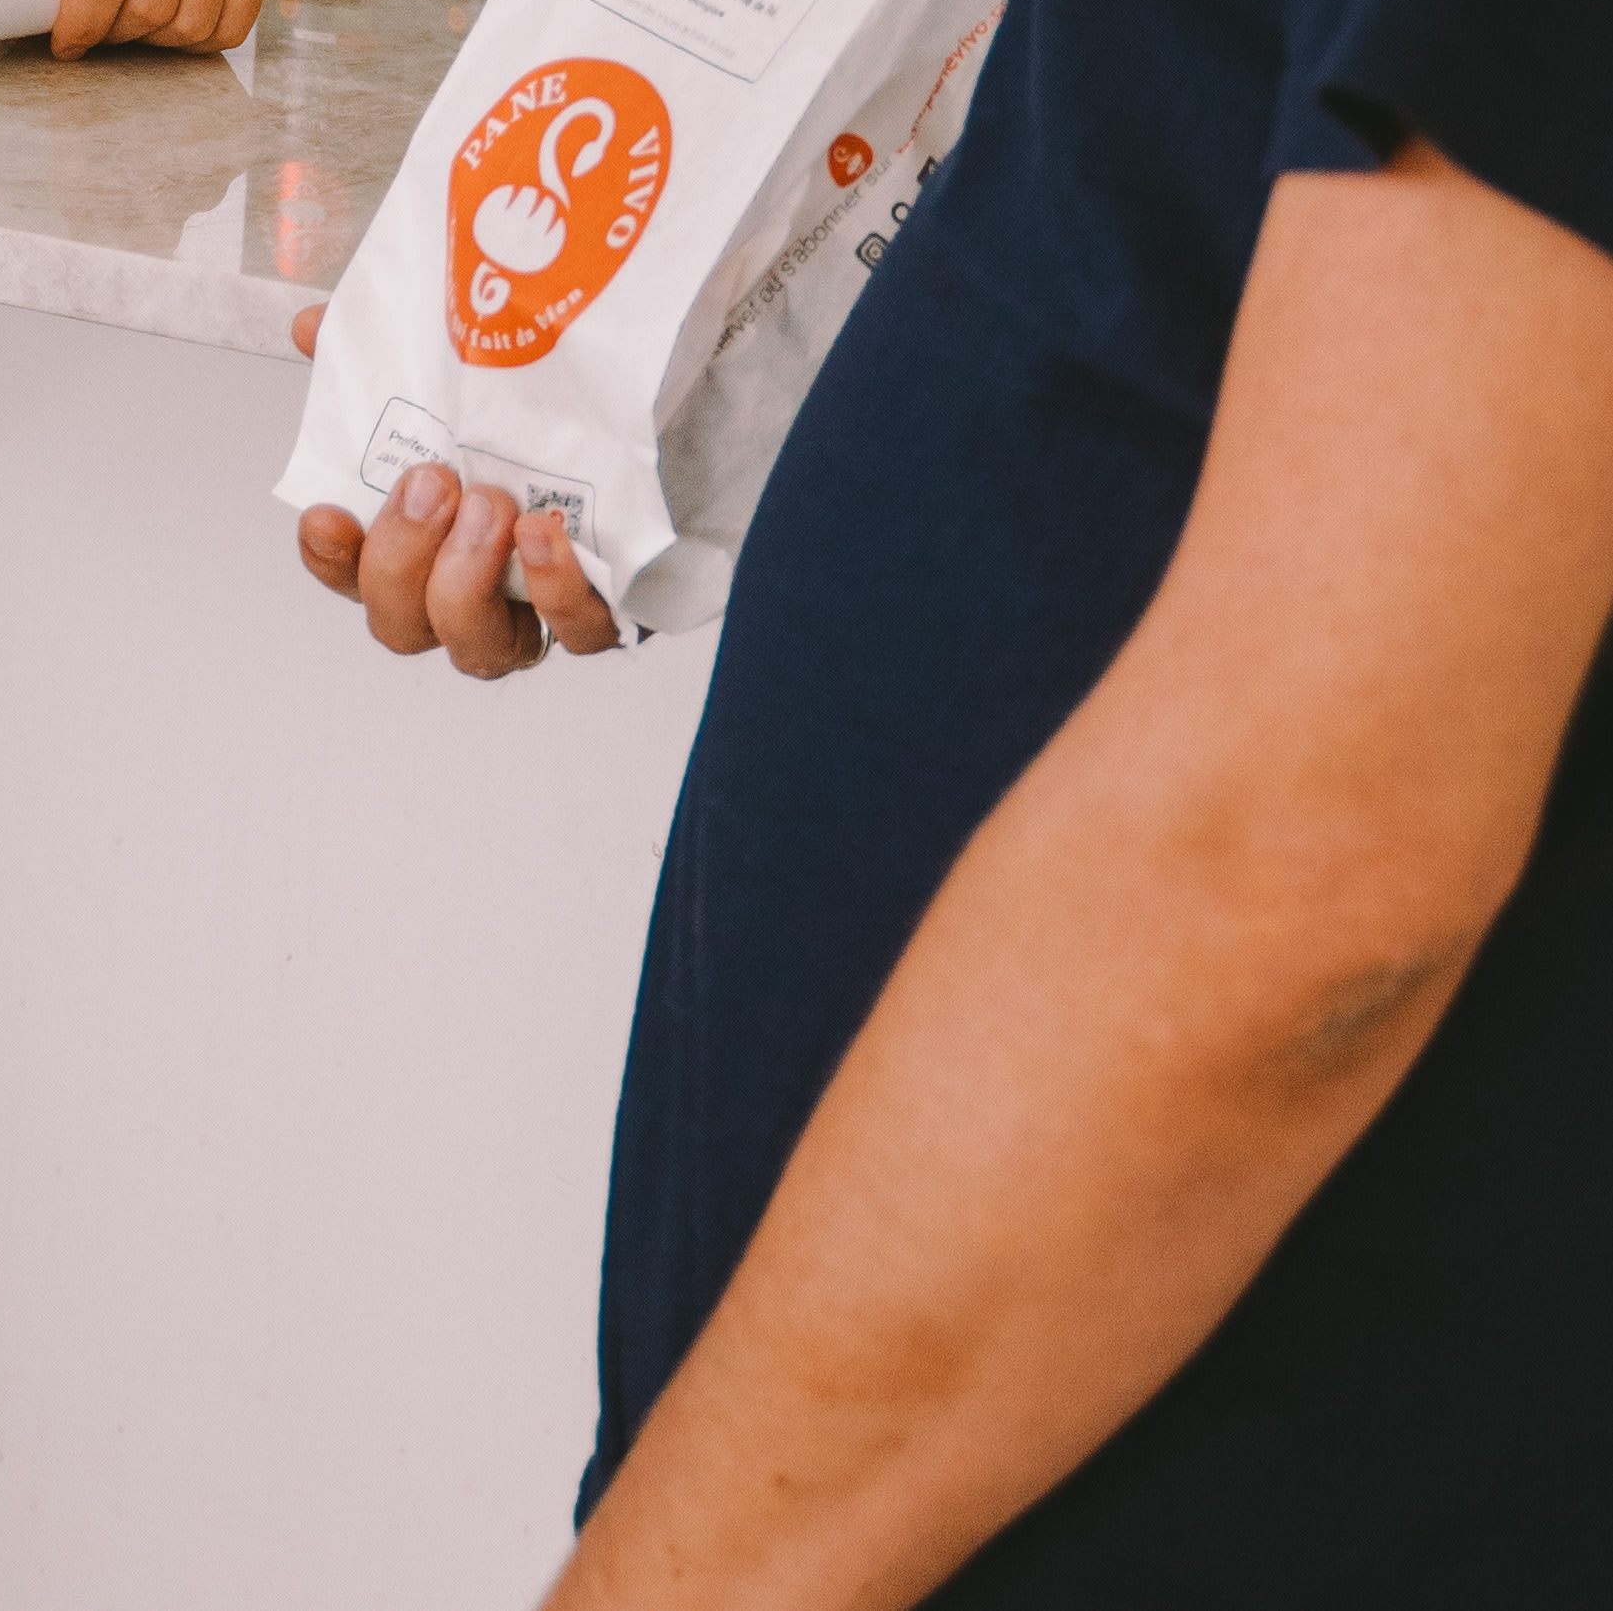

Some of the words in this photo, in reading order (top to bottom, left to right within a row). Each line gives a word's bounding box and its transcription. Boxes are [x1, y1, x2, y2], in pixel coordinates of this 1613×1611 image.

[461, 71, 568, 171] PANE
[605, 125, 660, 250] VIVO
[781, 185, 863, 276] s'abonner
[865, 156, 892, 186] sur
[470, 328, 511, 350] fait
[515, 327, 537, 348] du
[534, 288, 584, 331] bien
